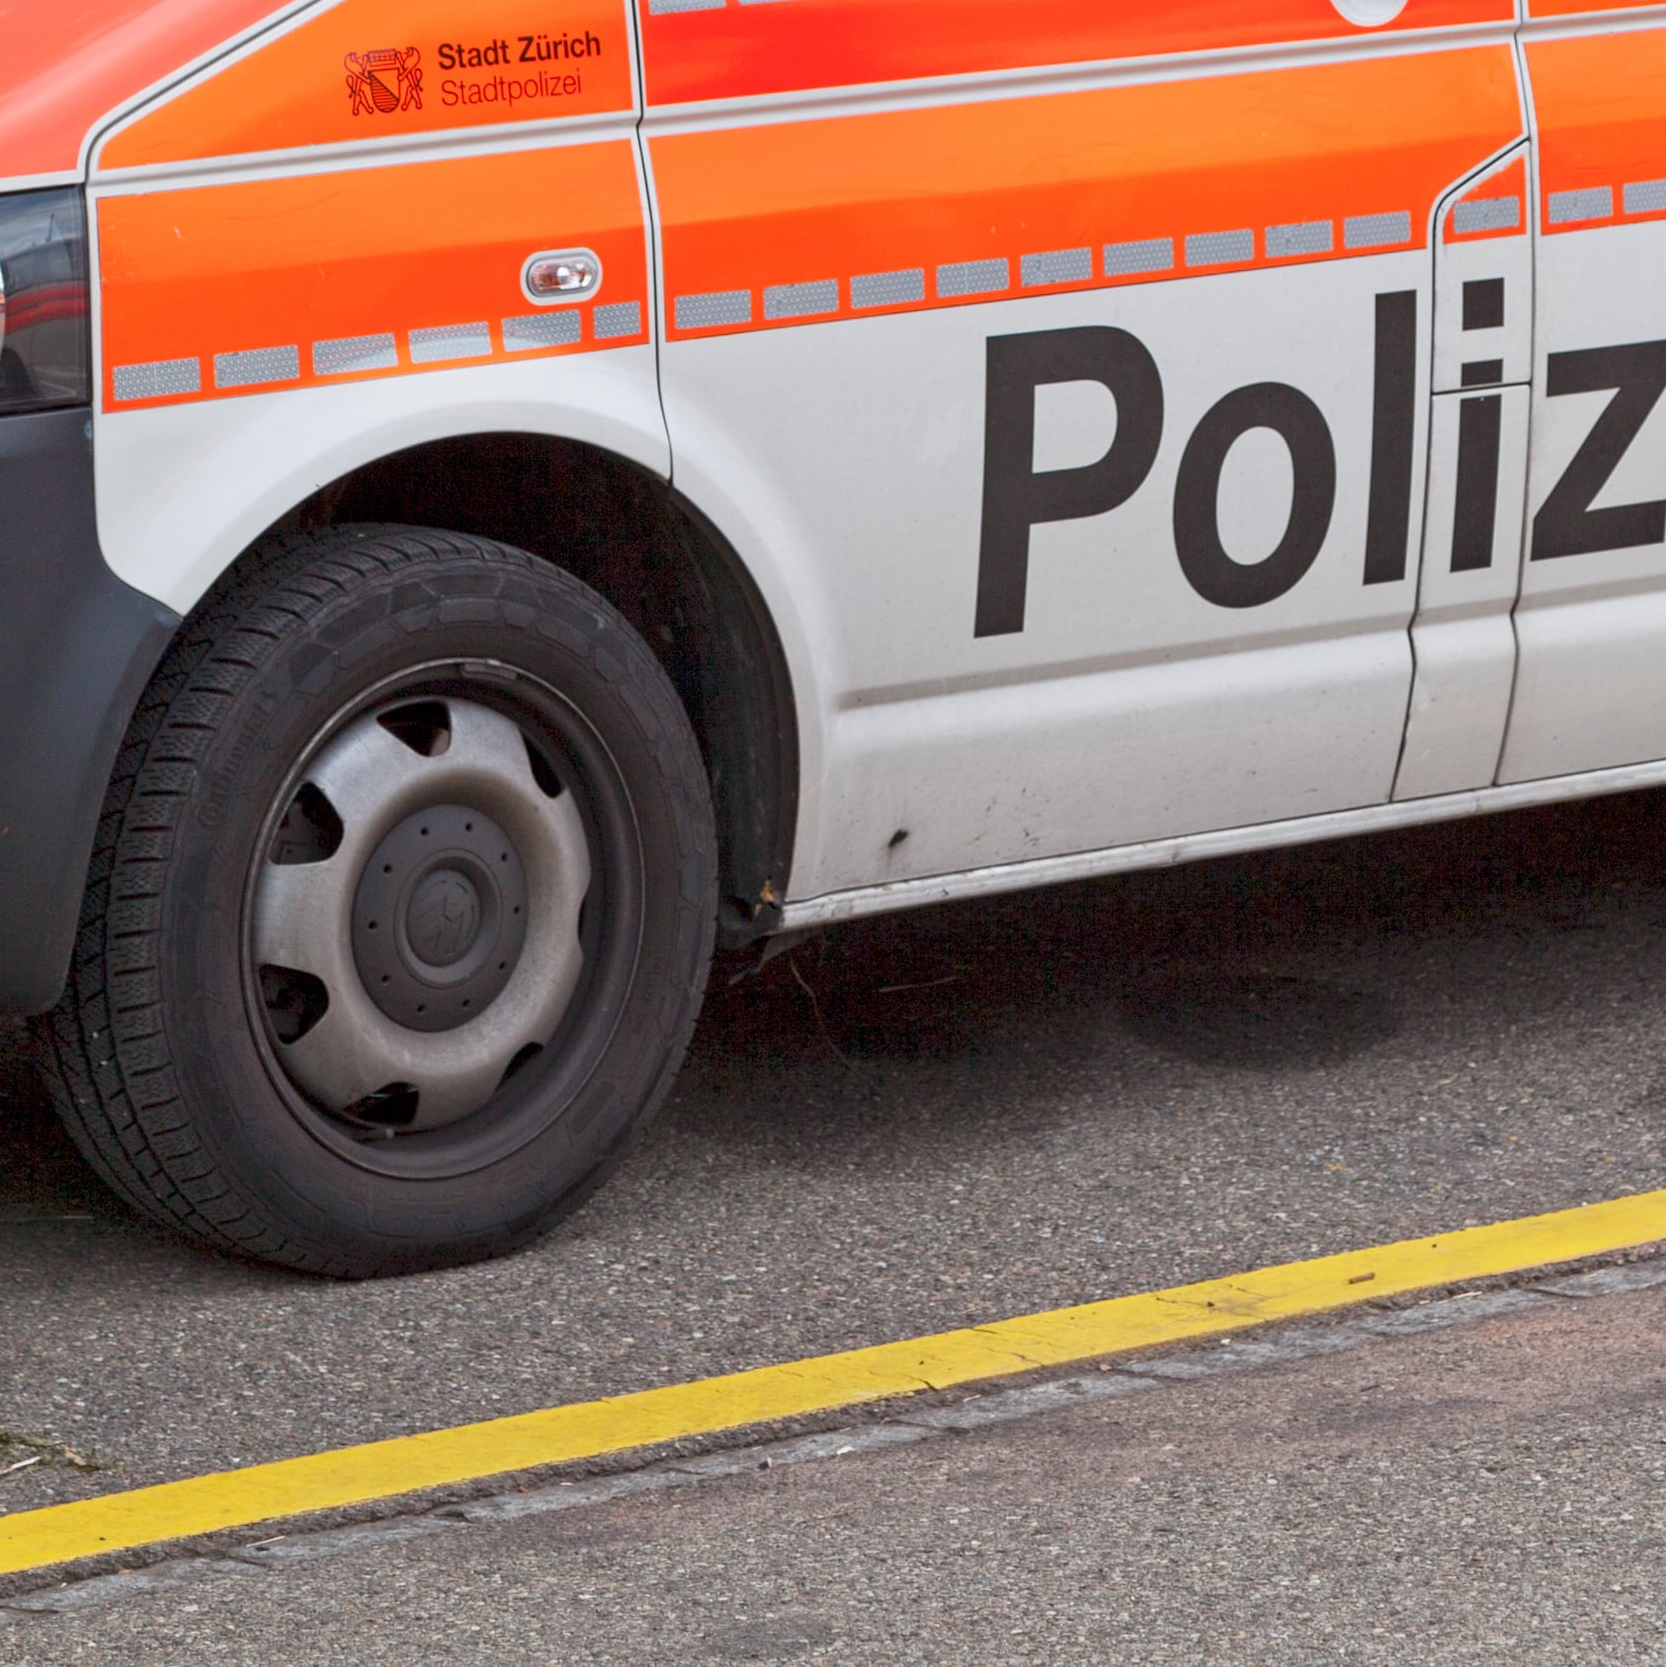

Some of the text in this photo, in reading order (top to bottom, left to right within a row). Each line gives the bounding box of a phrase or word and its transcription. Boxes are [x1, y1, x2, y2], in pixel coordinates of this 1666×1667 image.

[437, 31, 602, 70] Stadt Zürich
[440, 68, 583, 107] Stadtpolizei
